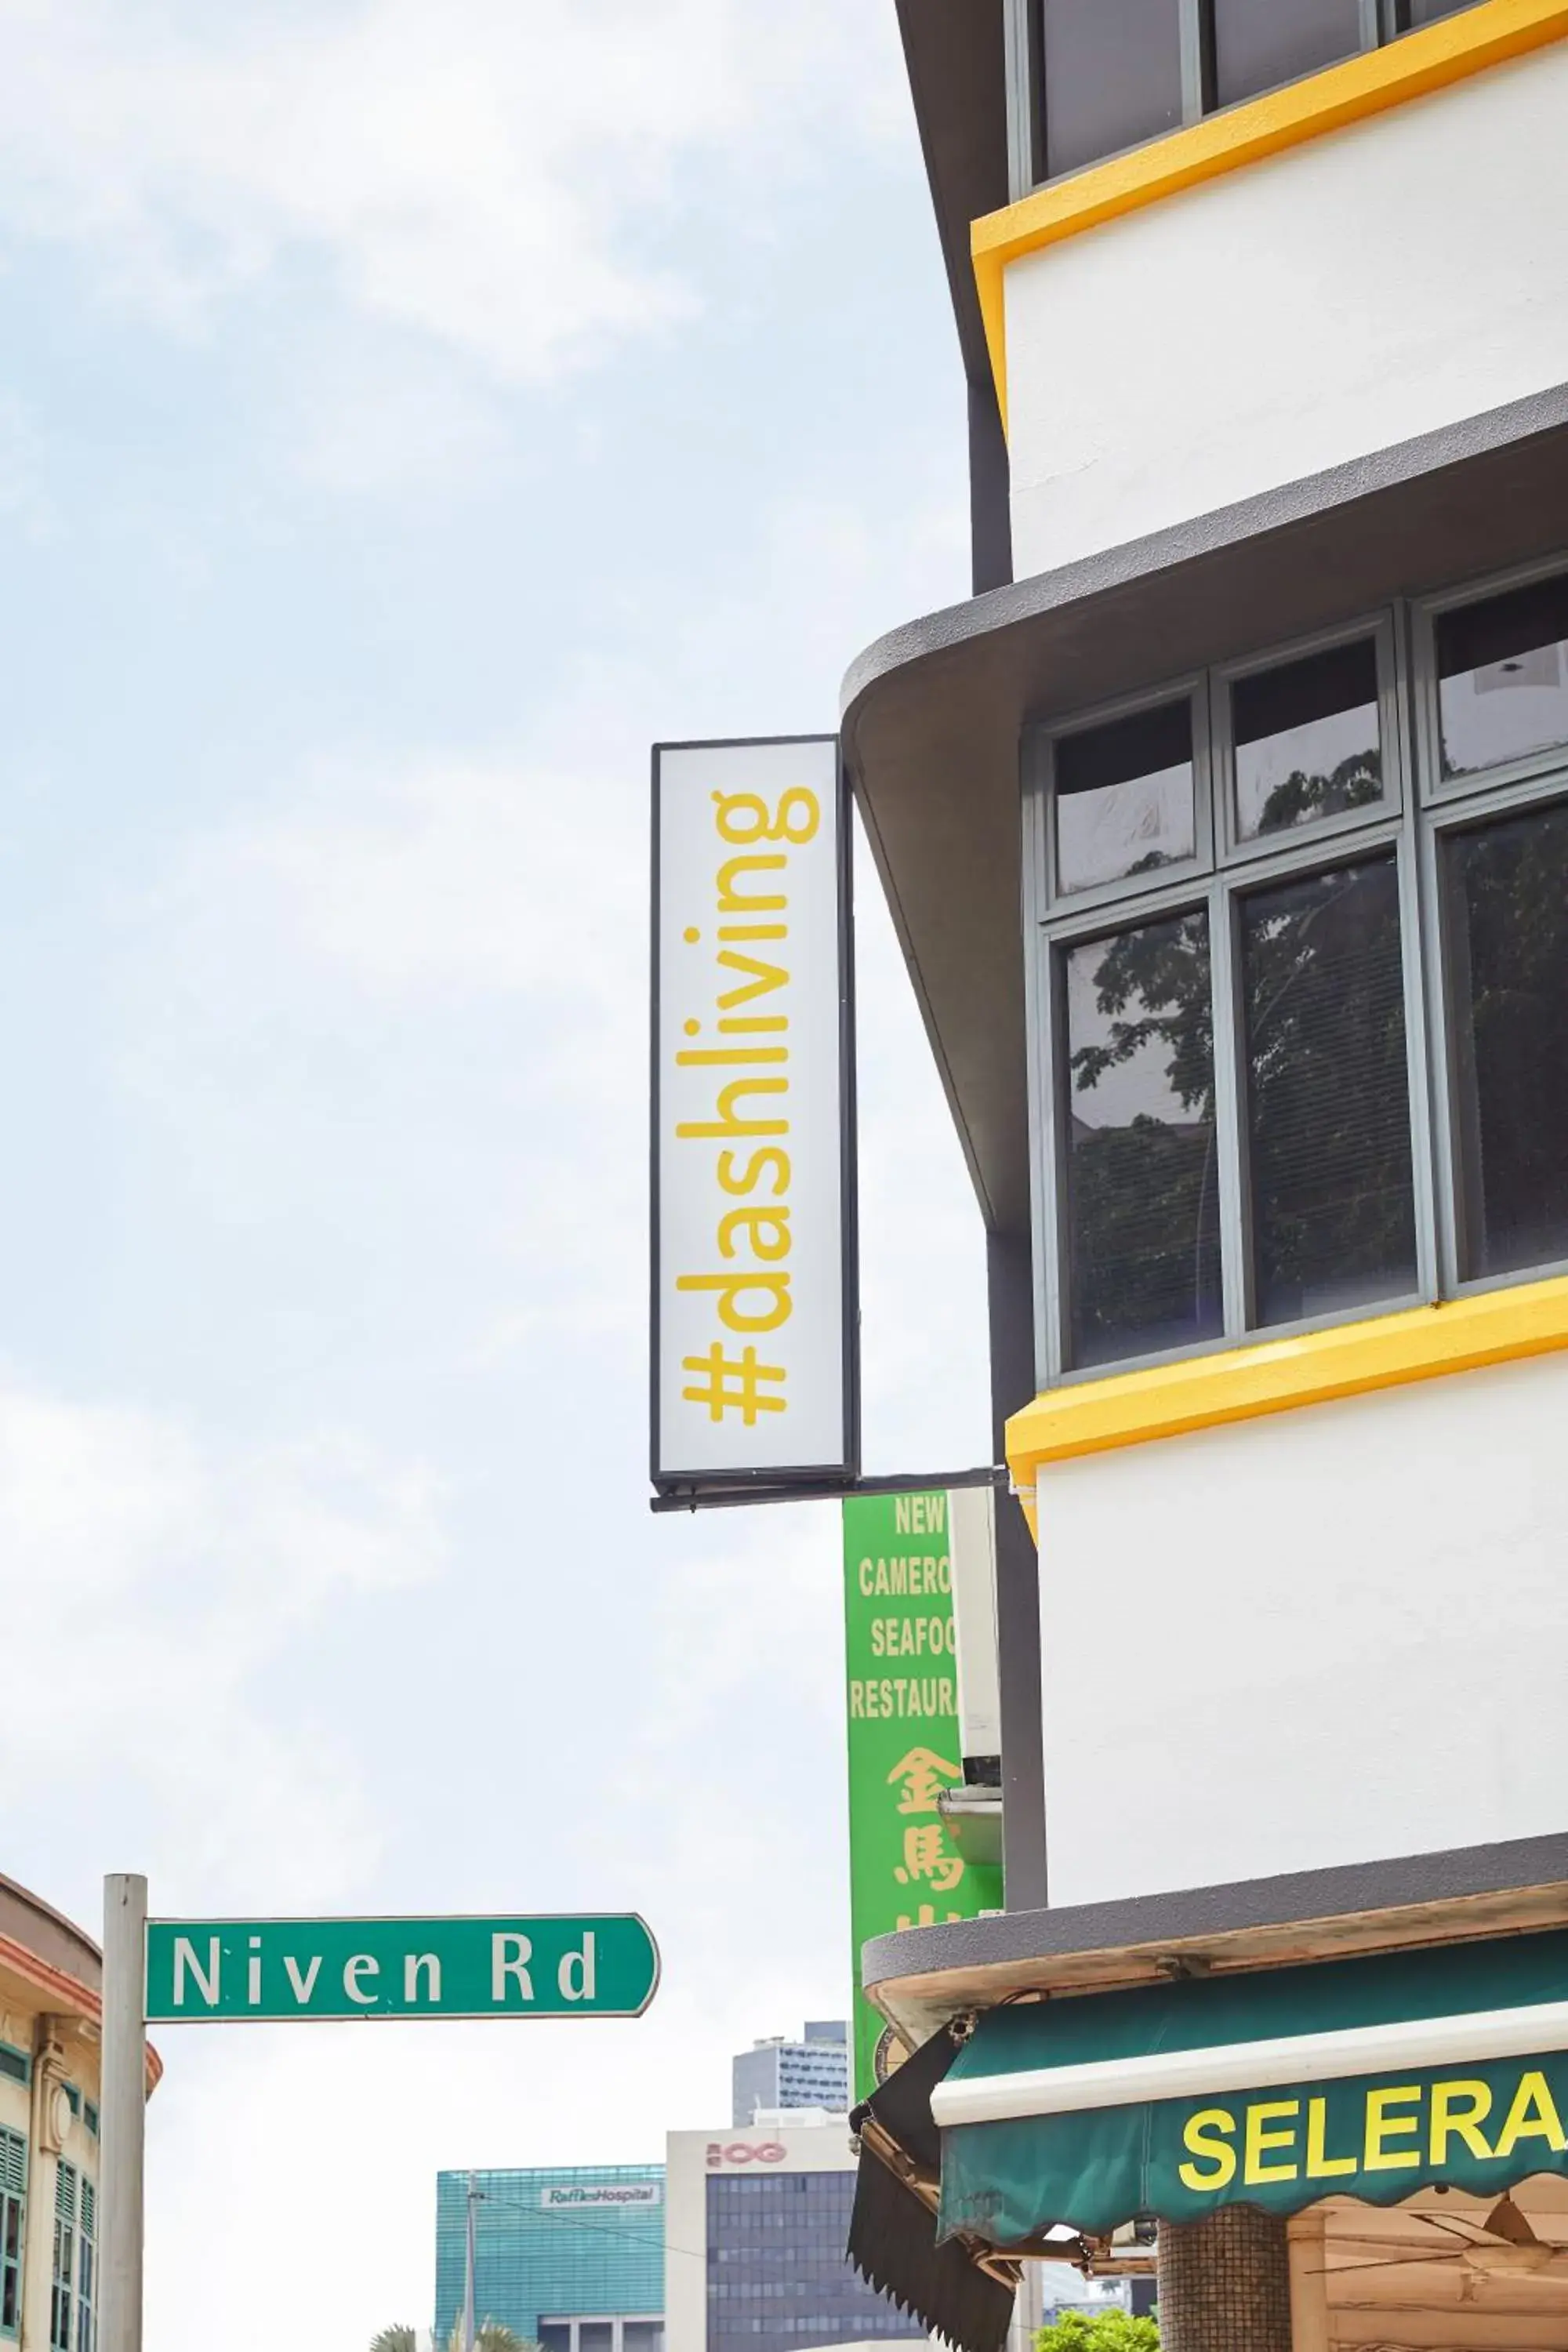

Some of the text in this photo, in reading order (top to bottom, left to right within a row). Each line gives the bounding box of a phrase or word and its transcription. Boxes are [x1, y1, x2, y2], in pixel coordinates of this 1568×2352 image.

[677, 787, 820, 1426] #dashliving
[895, 1495, 946, 1534] NEW
[850, 1677, 958, 1719] RESTAUR
[172, 1931, 597, 2005] Niven Rd
[1178, 2070, 1567, 2192] SELERA
